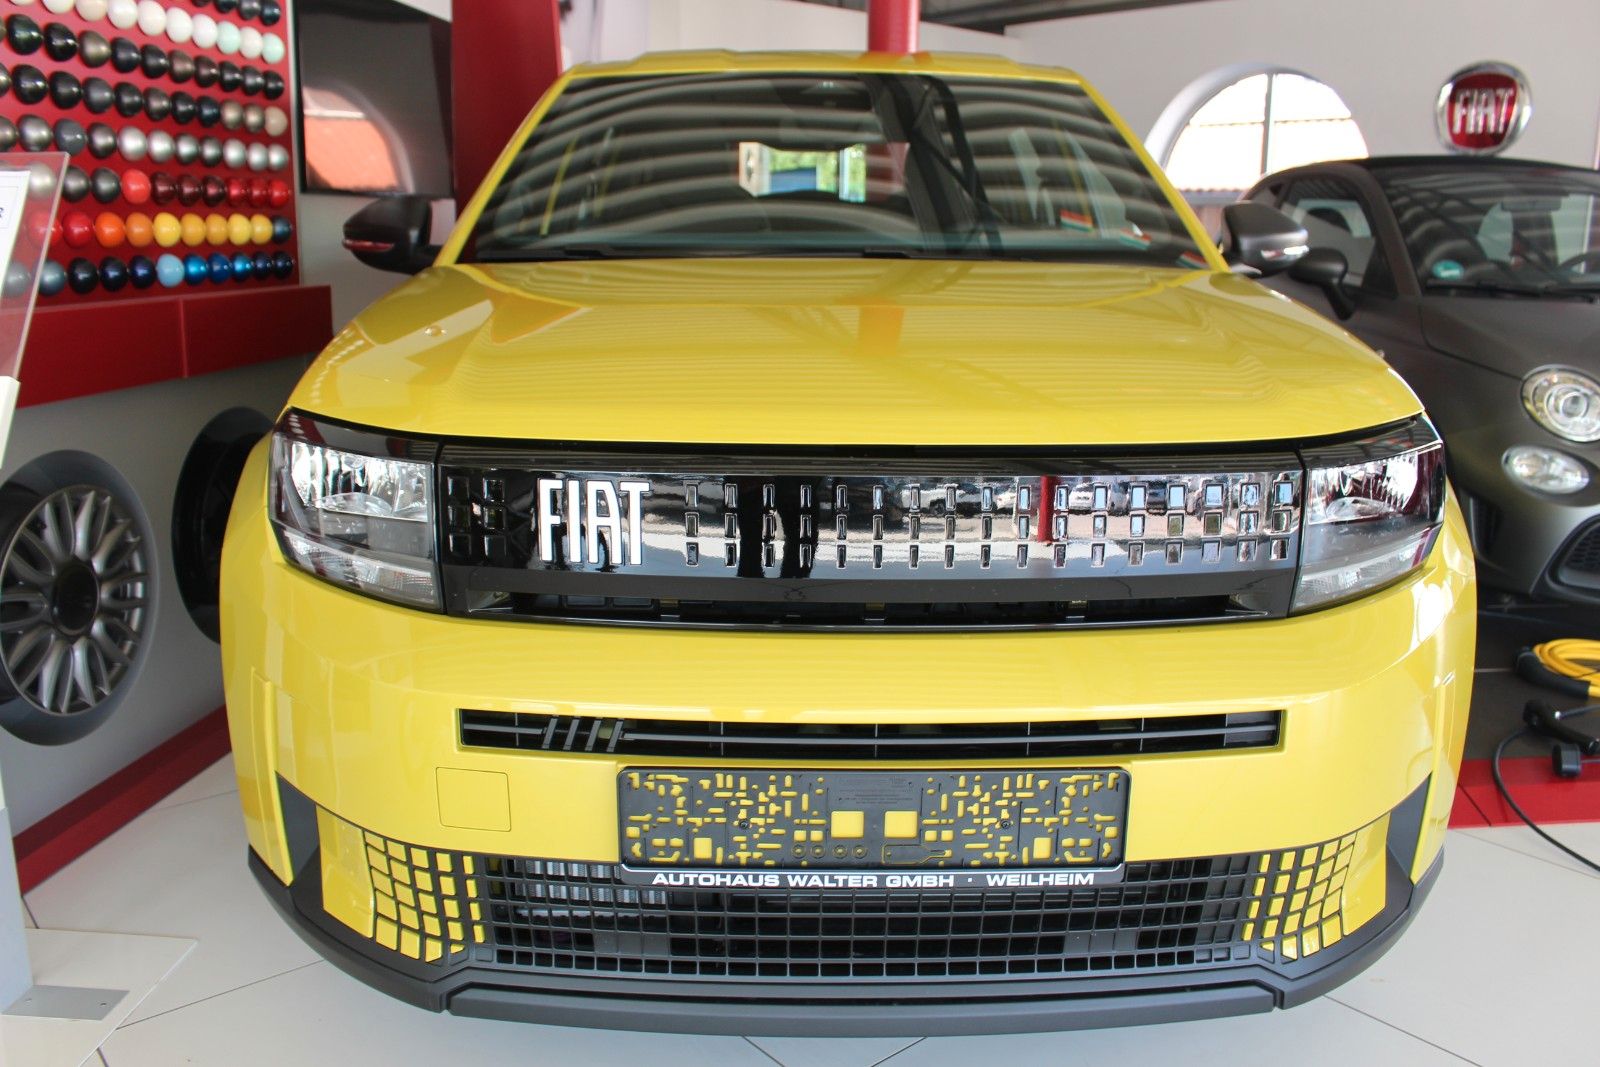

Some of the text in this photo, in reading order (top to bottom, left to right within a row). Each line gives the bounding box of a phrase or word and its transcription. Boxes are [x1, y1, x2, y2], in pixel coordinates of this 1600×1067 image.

[1453, 88, 1514, 134] FIAT
[538, 479, 650, 565] FIAT
[651, 873, 780, 887] AUTOHAUS
[787, 874, 878, 888] WALTER
[885, 874, 954, 888] GMBH
[986, 873, 1095, 887] WEILHEIM
